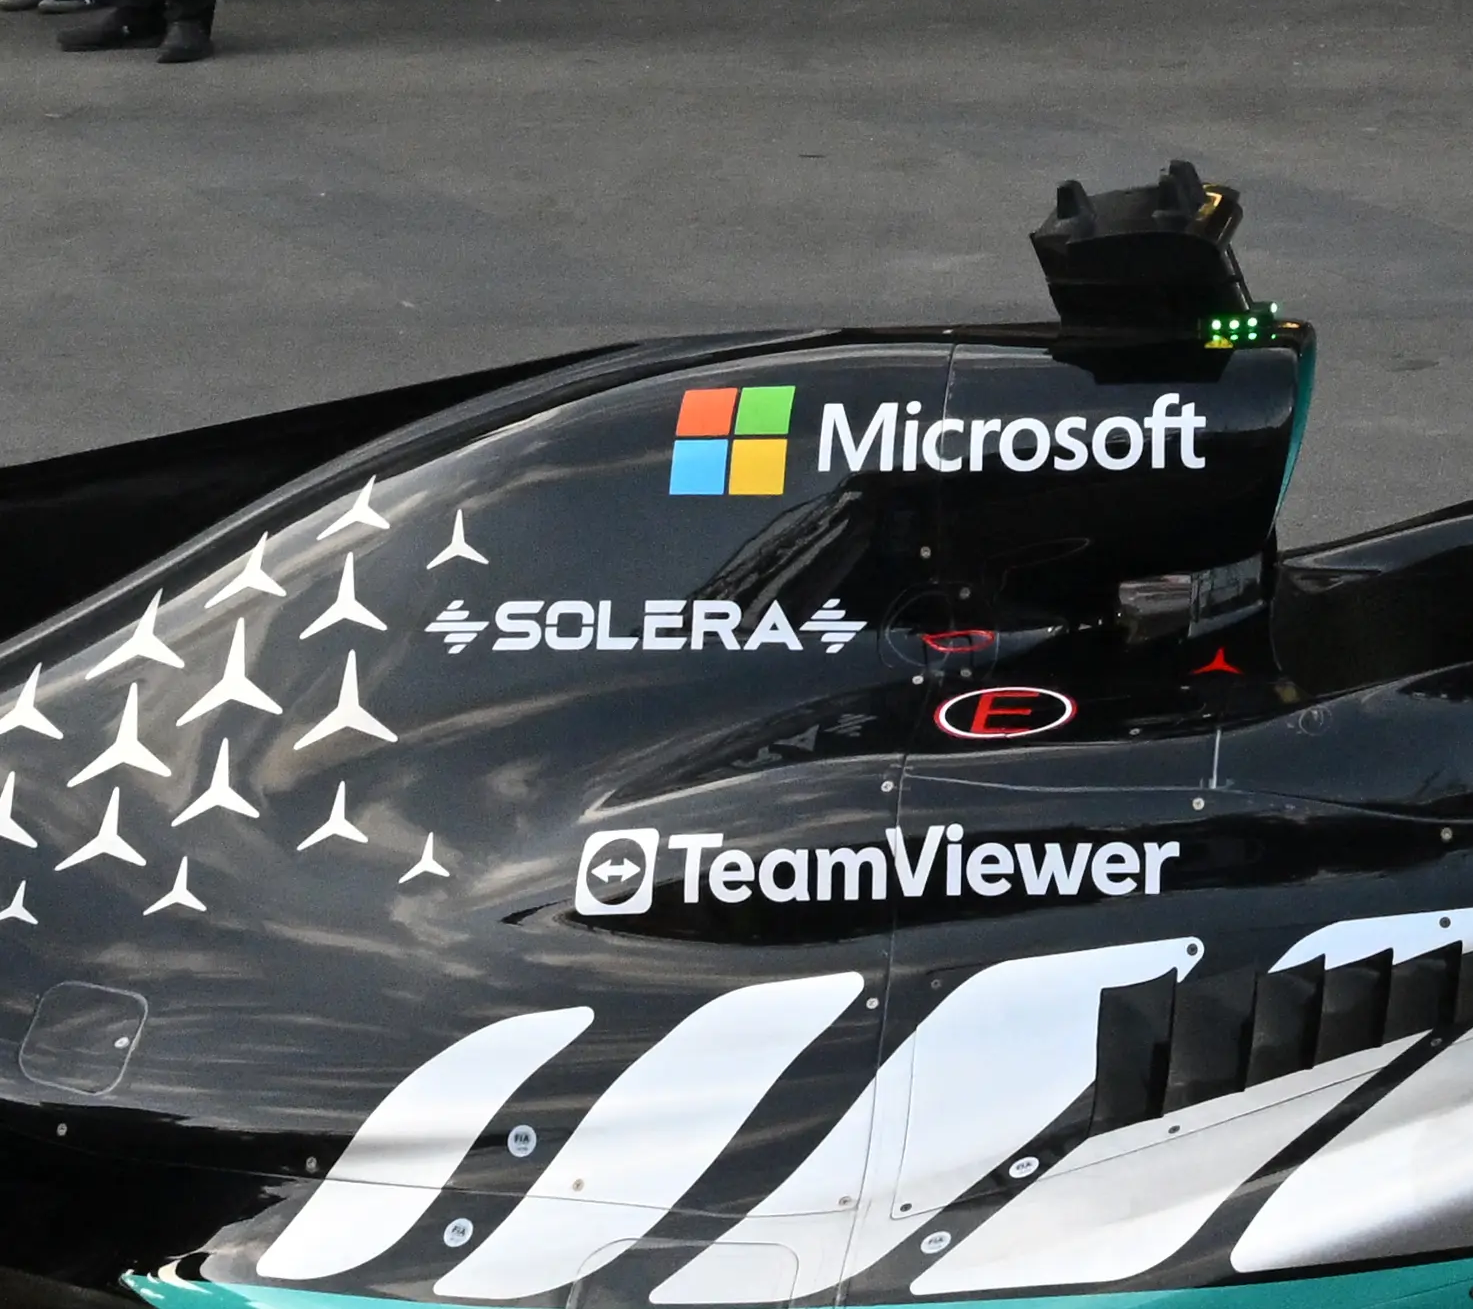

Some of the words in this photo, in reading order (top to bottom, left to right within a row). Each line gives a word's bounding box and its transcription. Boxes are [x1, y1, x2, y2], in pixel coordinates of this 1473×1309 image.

[818, 392, 1206, 473] Microsoft
[494, 600, 803, 651] SOLERA
[974, 690, 1033, 733] E
[668, 823, 1181, 903] TeamViewer
